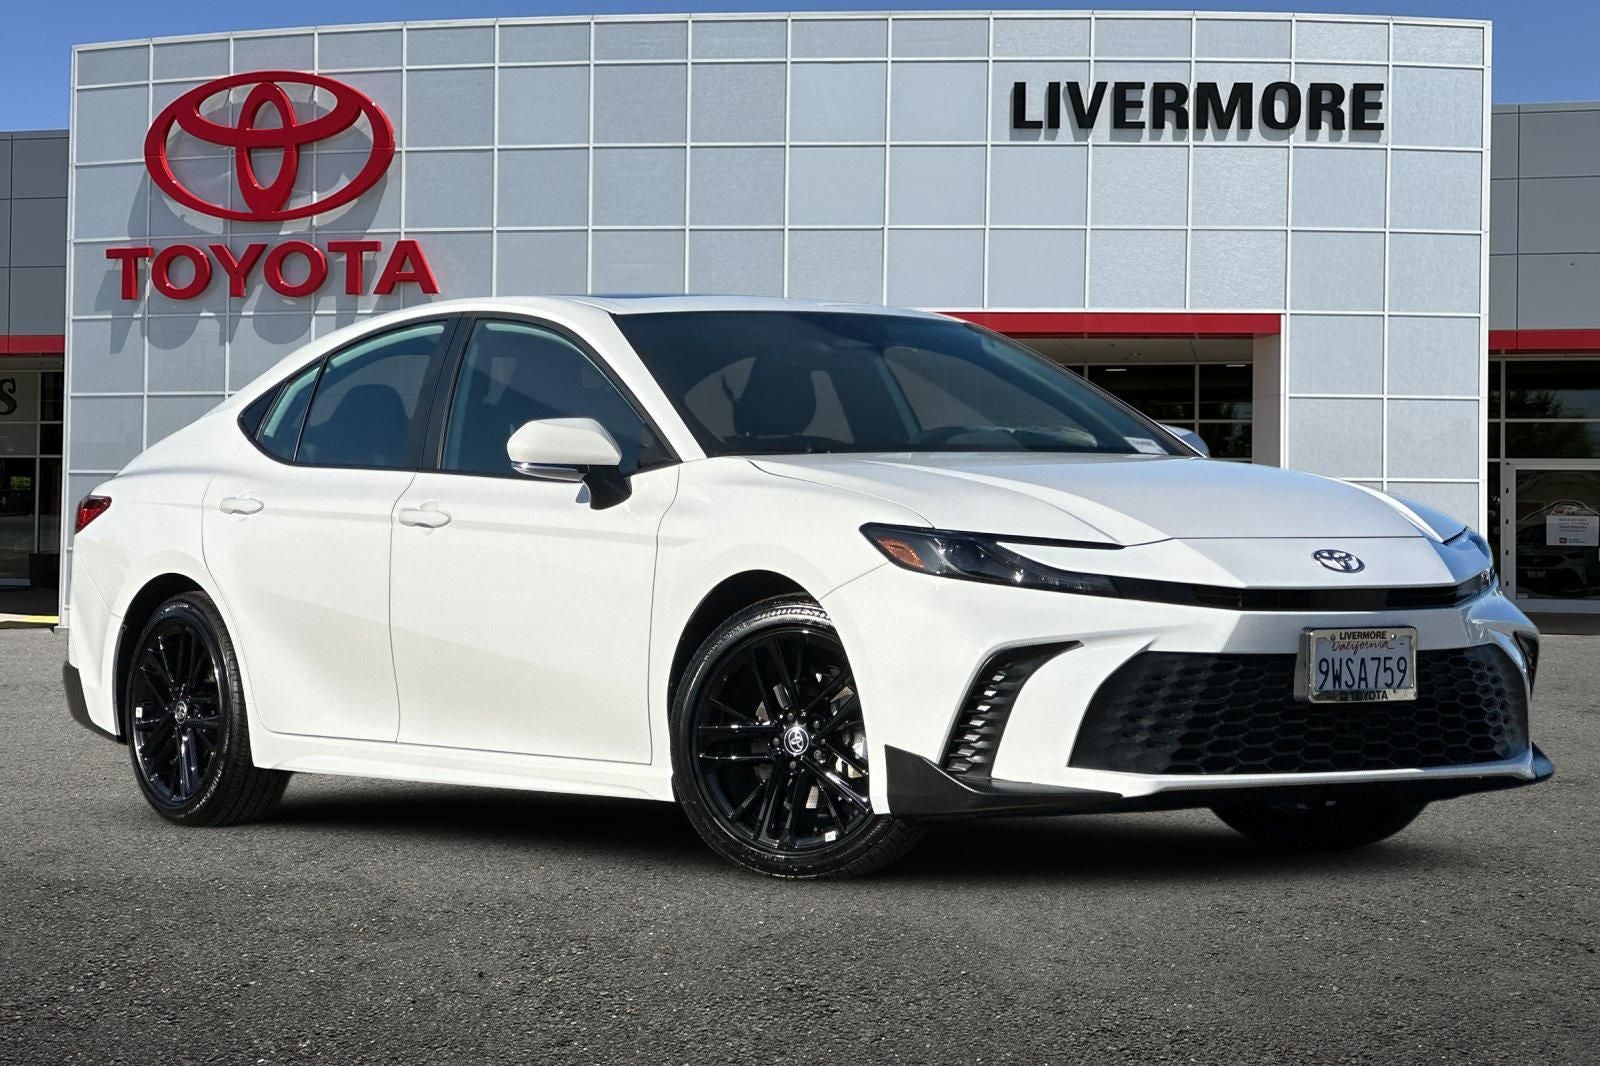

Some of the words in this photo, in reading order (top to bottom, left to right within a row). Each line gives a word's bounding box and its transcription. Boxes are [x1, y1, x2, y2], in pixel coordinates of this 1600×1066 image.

[1013, 81, 1385, 131] LIVERMORE
[105, 240, 440, 301] TOYOTA
[1332, 640, 1395, 655] California
[1340, 631, 1387, 640] LIVERMORE
[1318, 656, 1408, 690] 9WSA759
[1350, 690, 1388, 700] YOTA
